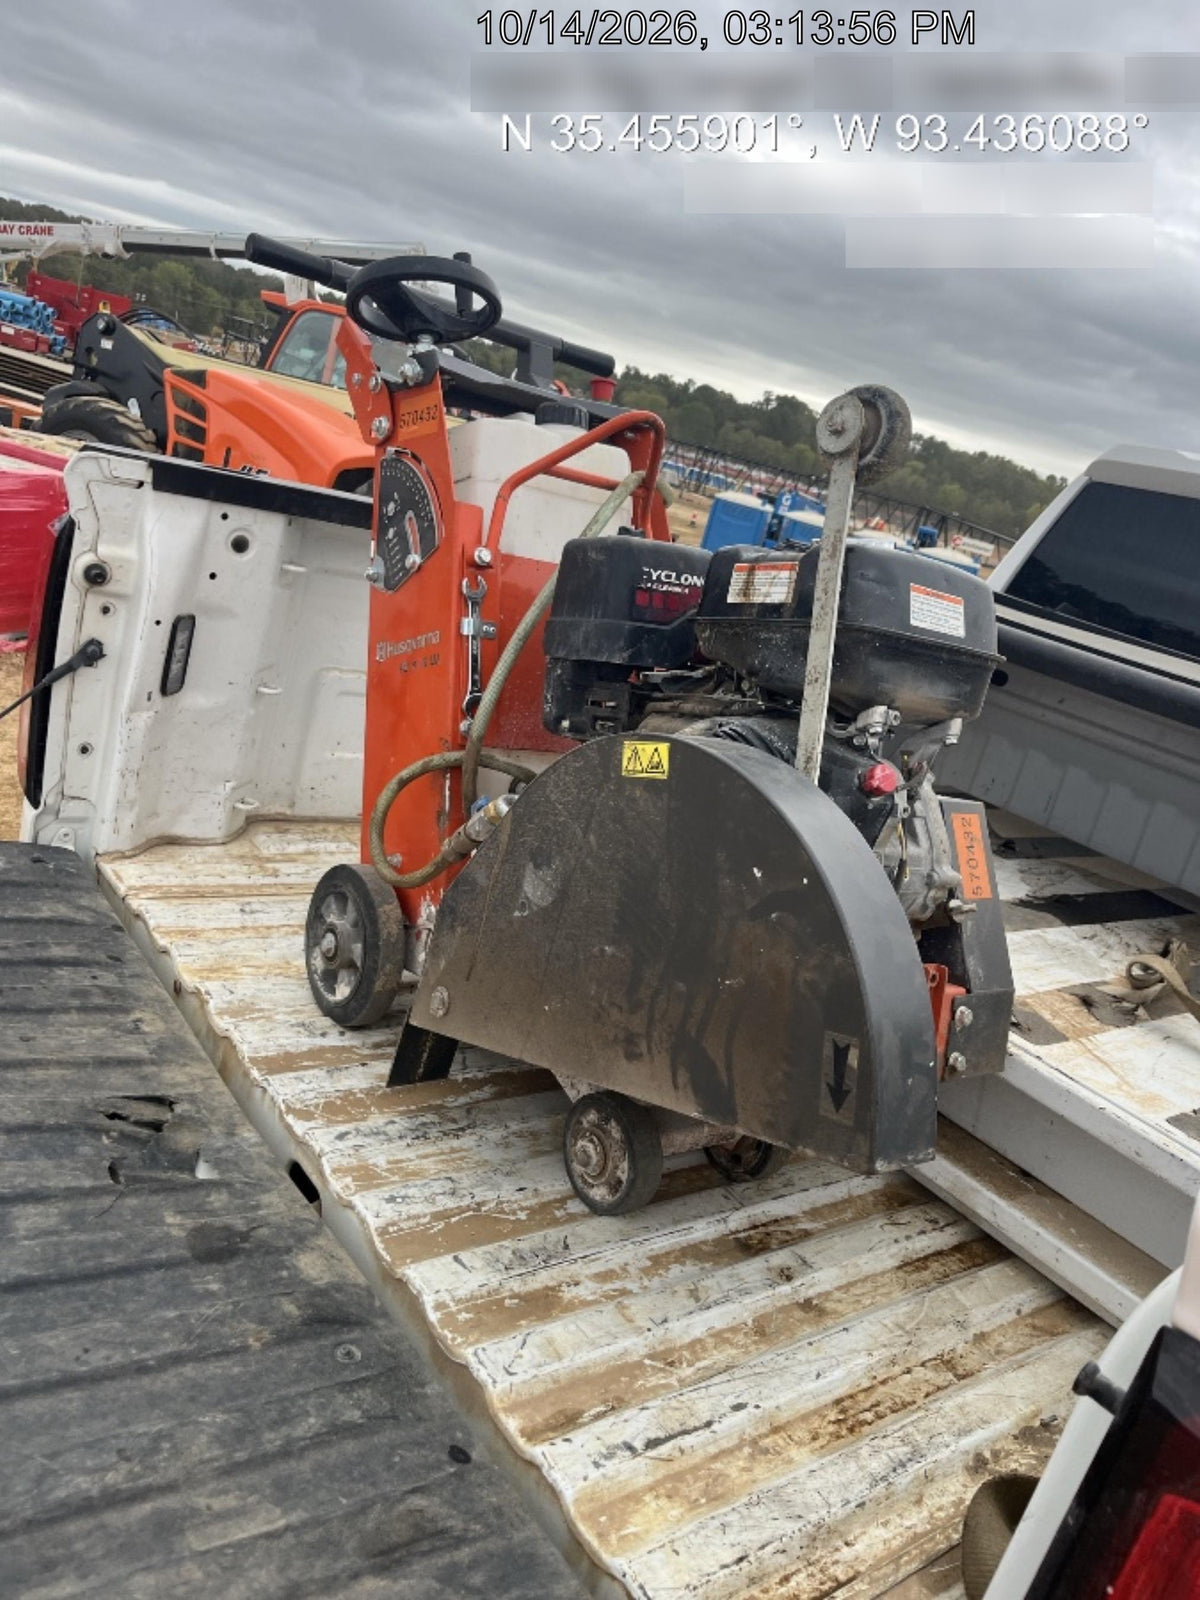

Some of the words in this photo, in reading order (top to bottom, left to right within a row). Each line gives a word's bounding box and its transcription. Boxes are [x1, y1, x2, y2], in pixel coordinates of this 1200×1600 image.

[0, 223, 14, 235] AY
[18, 224, 55, 236] CRANE
[960, 816, 984, 897] 570432
